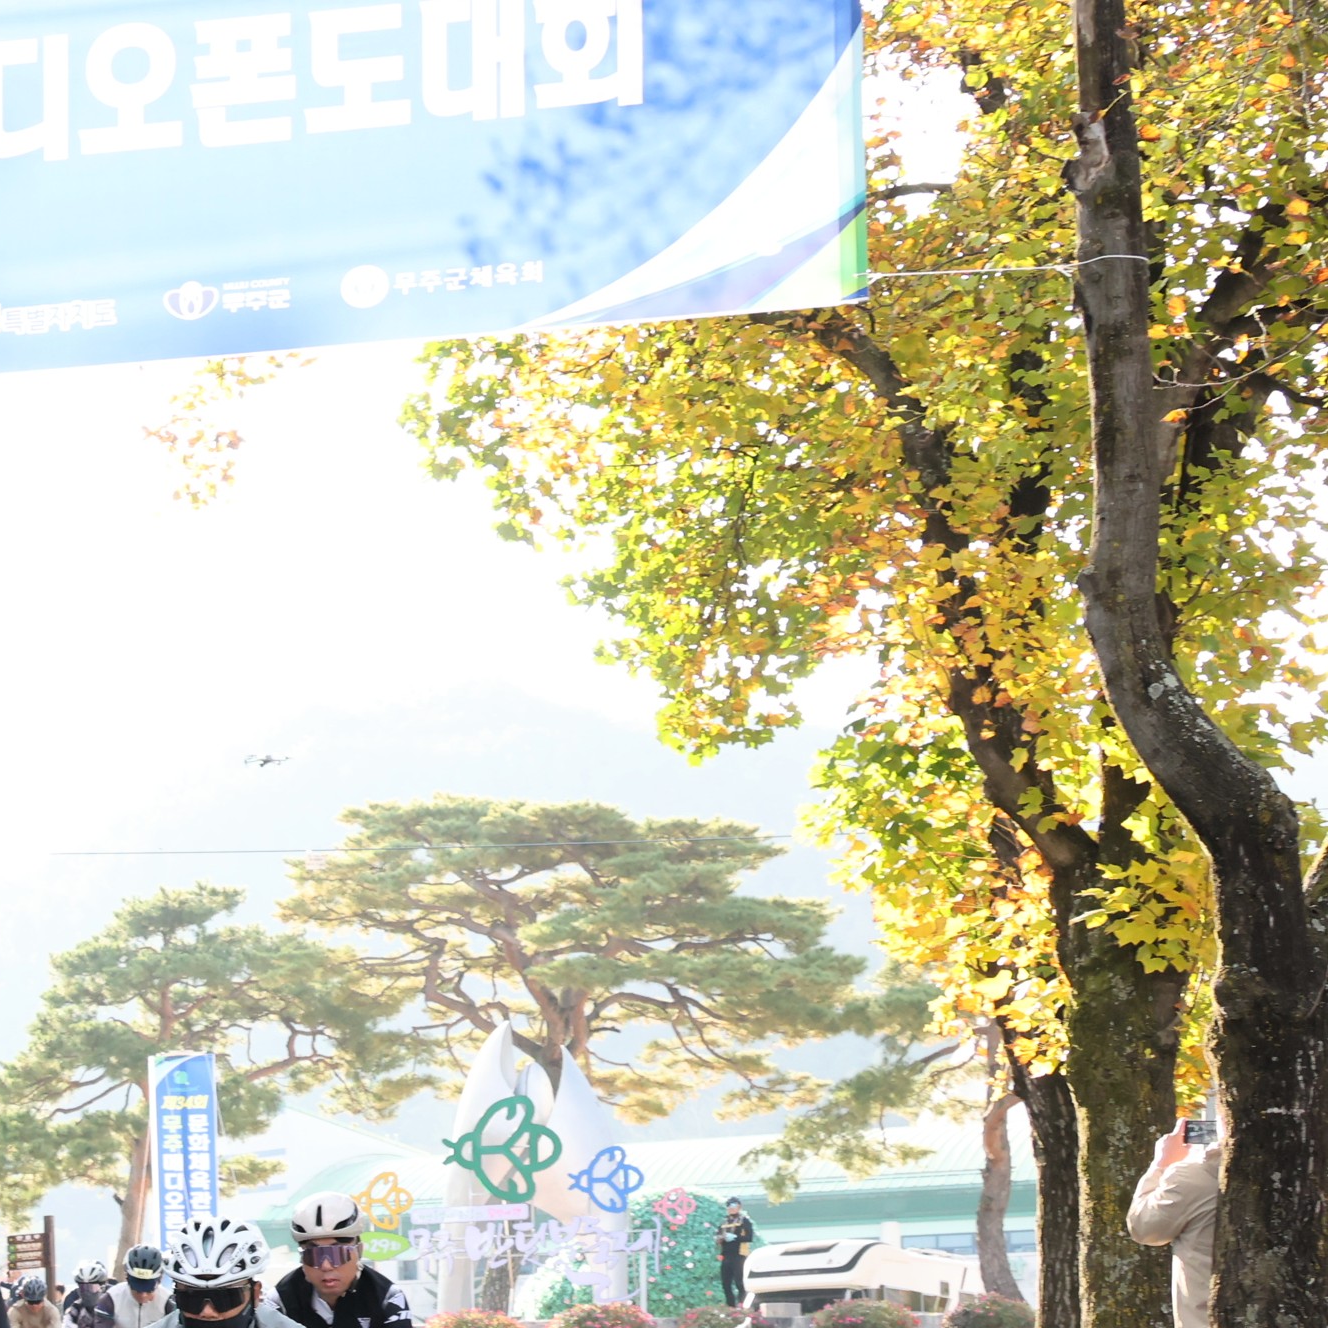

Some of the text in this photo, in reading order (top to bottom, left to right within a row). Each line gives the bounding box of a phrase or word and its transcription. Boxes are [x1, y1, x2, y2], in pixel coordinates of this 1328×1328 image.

[393, 260, 545, 295] 무주군체육회
[221, 288, 293, 313] 무주군
[161, 1095, 209, 1111] 제34회
